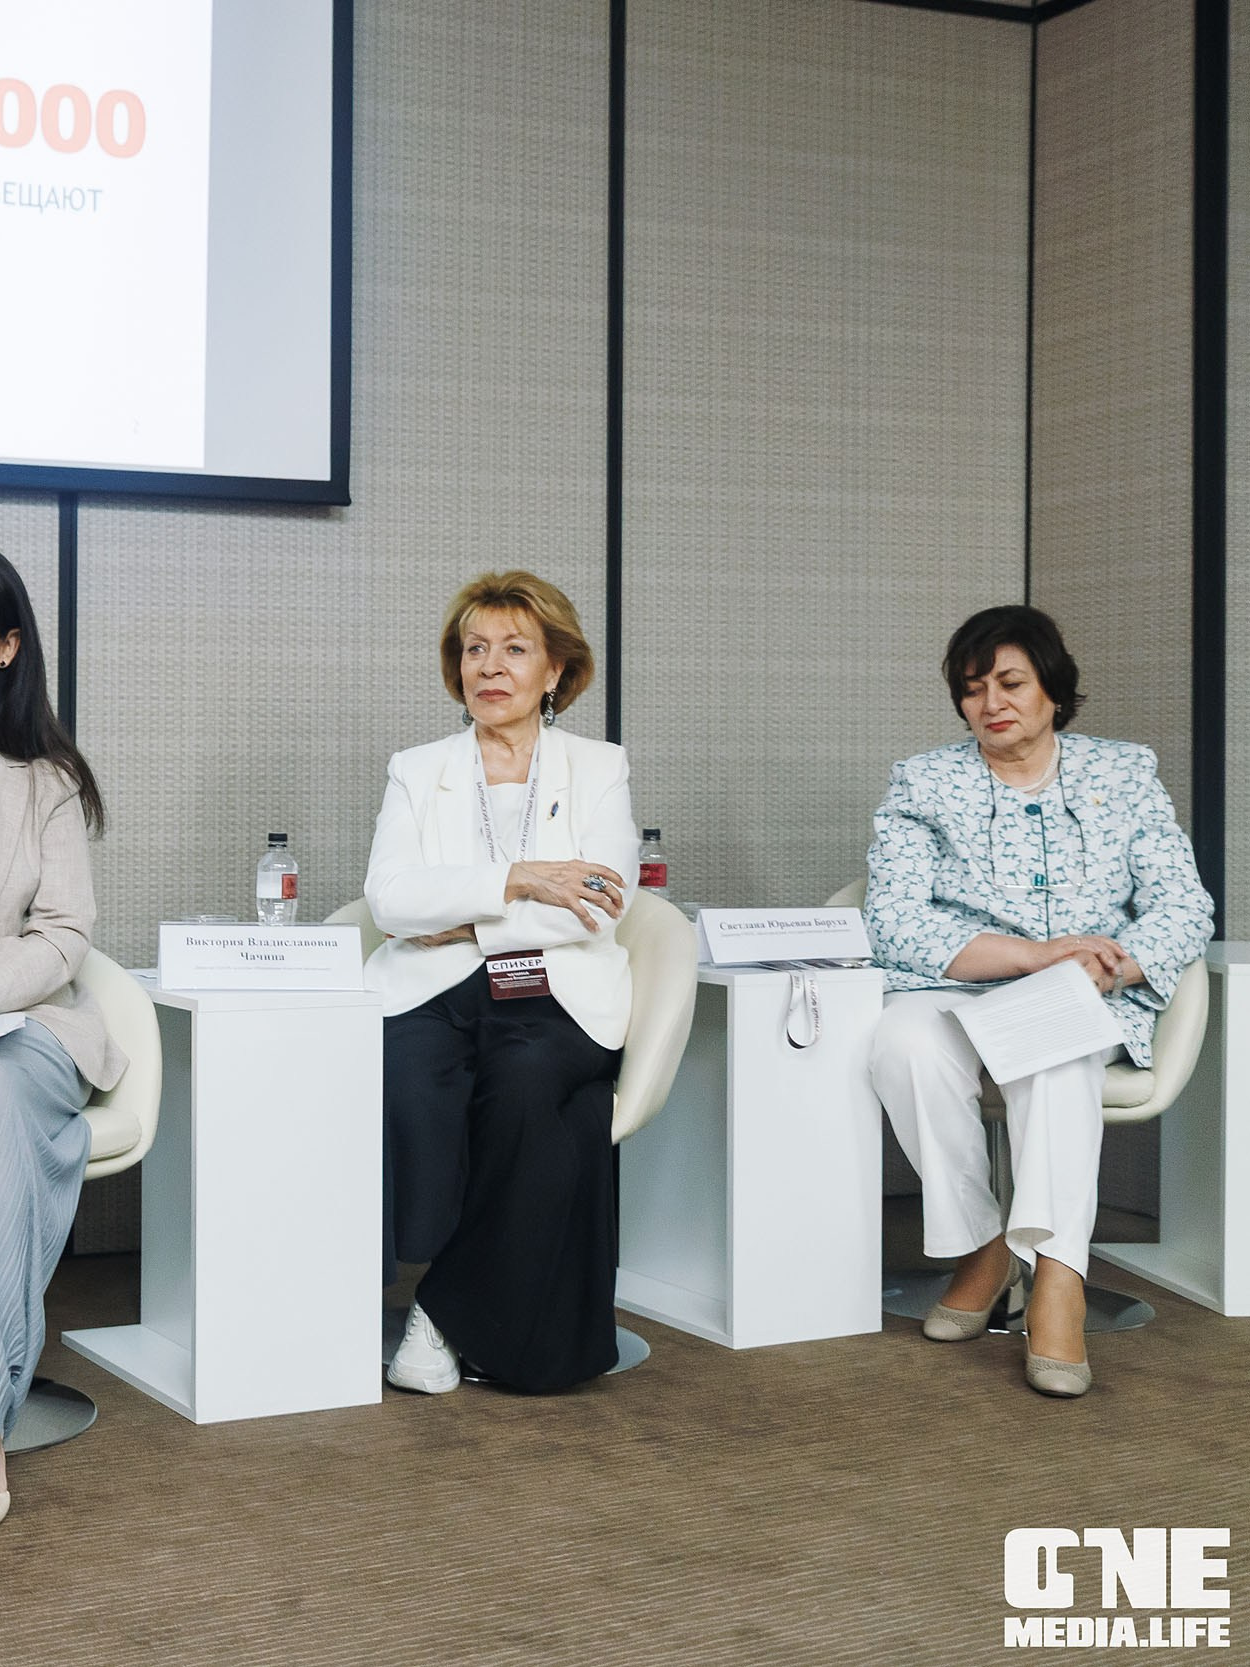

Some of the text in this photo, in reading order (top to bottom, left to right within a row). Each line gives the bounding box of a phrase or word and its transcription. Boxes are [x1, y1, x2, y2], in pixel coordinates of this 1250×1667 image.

[719, 921, 766, 930] Светлана
[767, 919, 812, 930] Юрьевна
[186, 937, 338, 949] Виктория Владиславовна
[240, 951, 285, 961] Чачина
[492, 958, 542, 970] СПИКЕР
